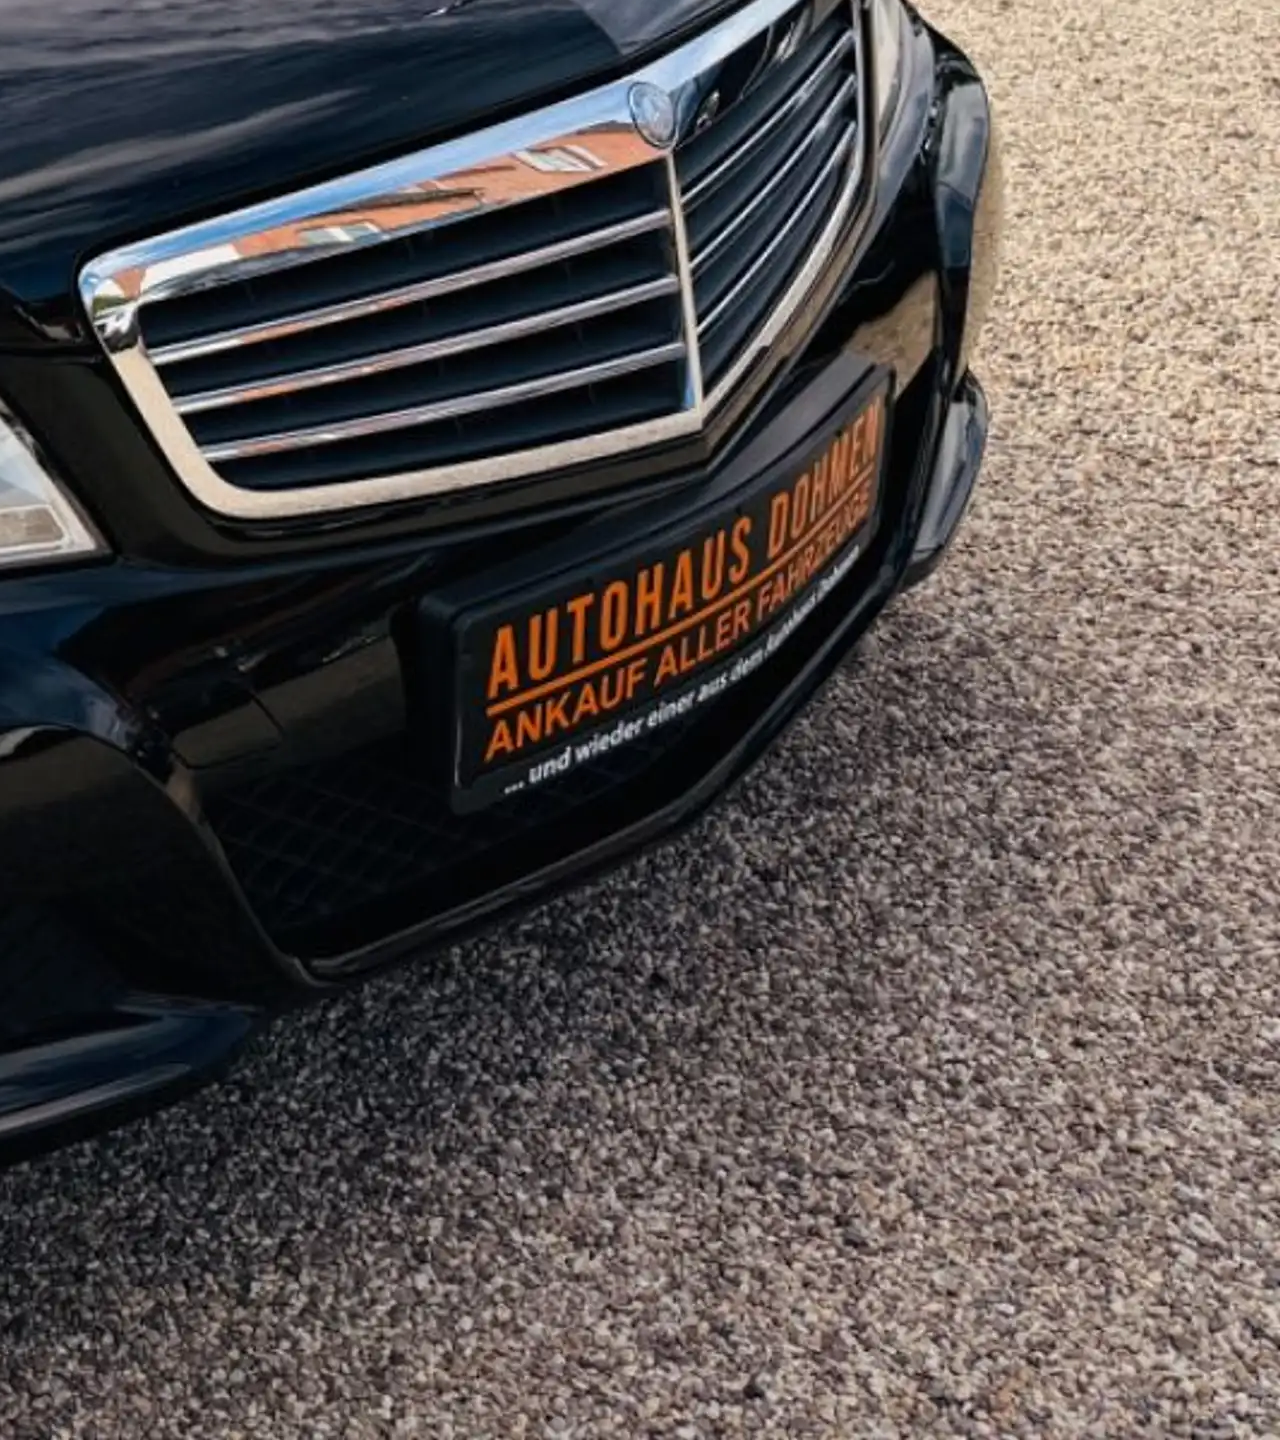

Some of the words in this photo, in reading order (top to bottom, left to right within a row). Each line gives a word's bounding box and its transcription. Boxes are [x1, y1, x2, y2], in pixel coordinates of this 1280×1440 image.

[487, 517, 752, 699] AUTOHAUS
[768, 395, 881, 558] DOHMEN
[484, 658, 648, 761] ANKAUF
[653, 598, 750, 688] ALLER
[528, 746, 572, 784] und
[575, 716, 645, 762] wieder
[646, 690, 696, 728] einer
